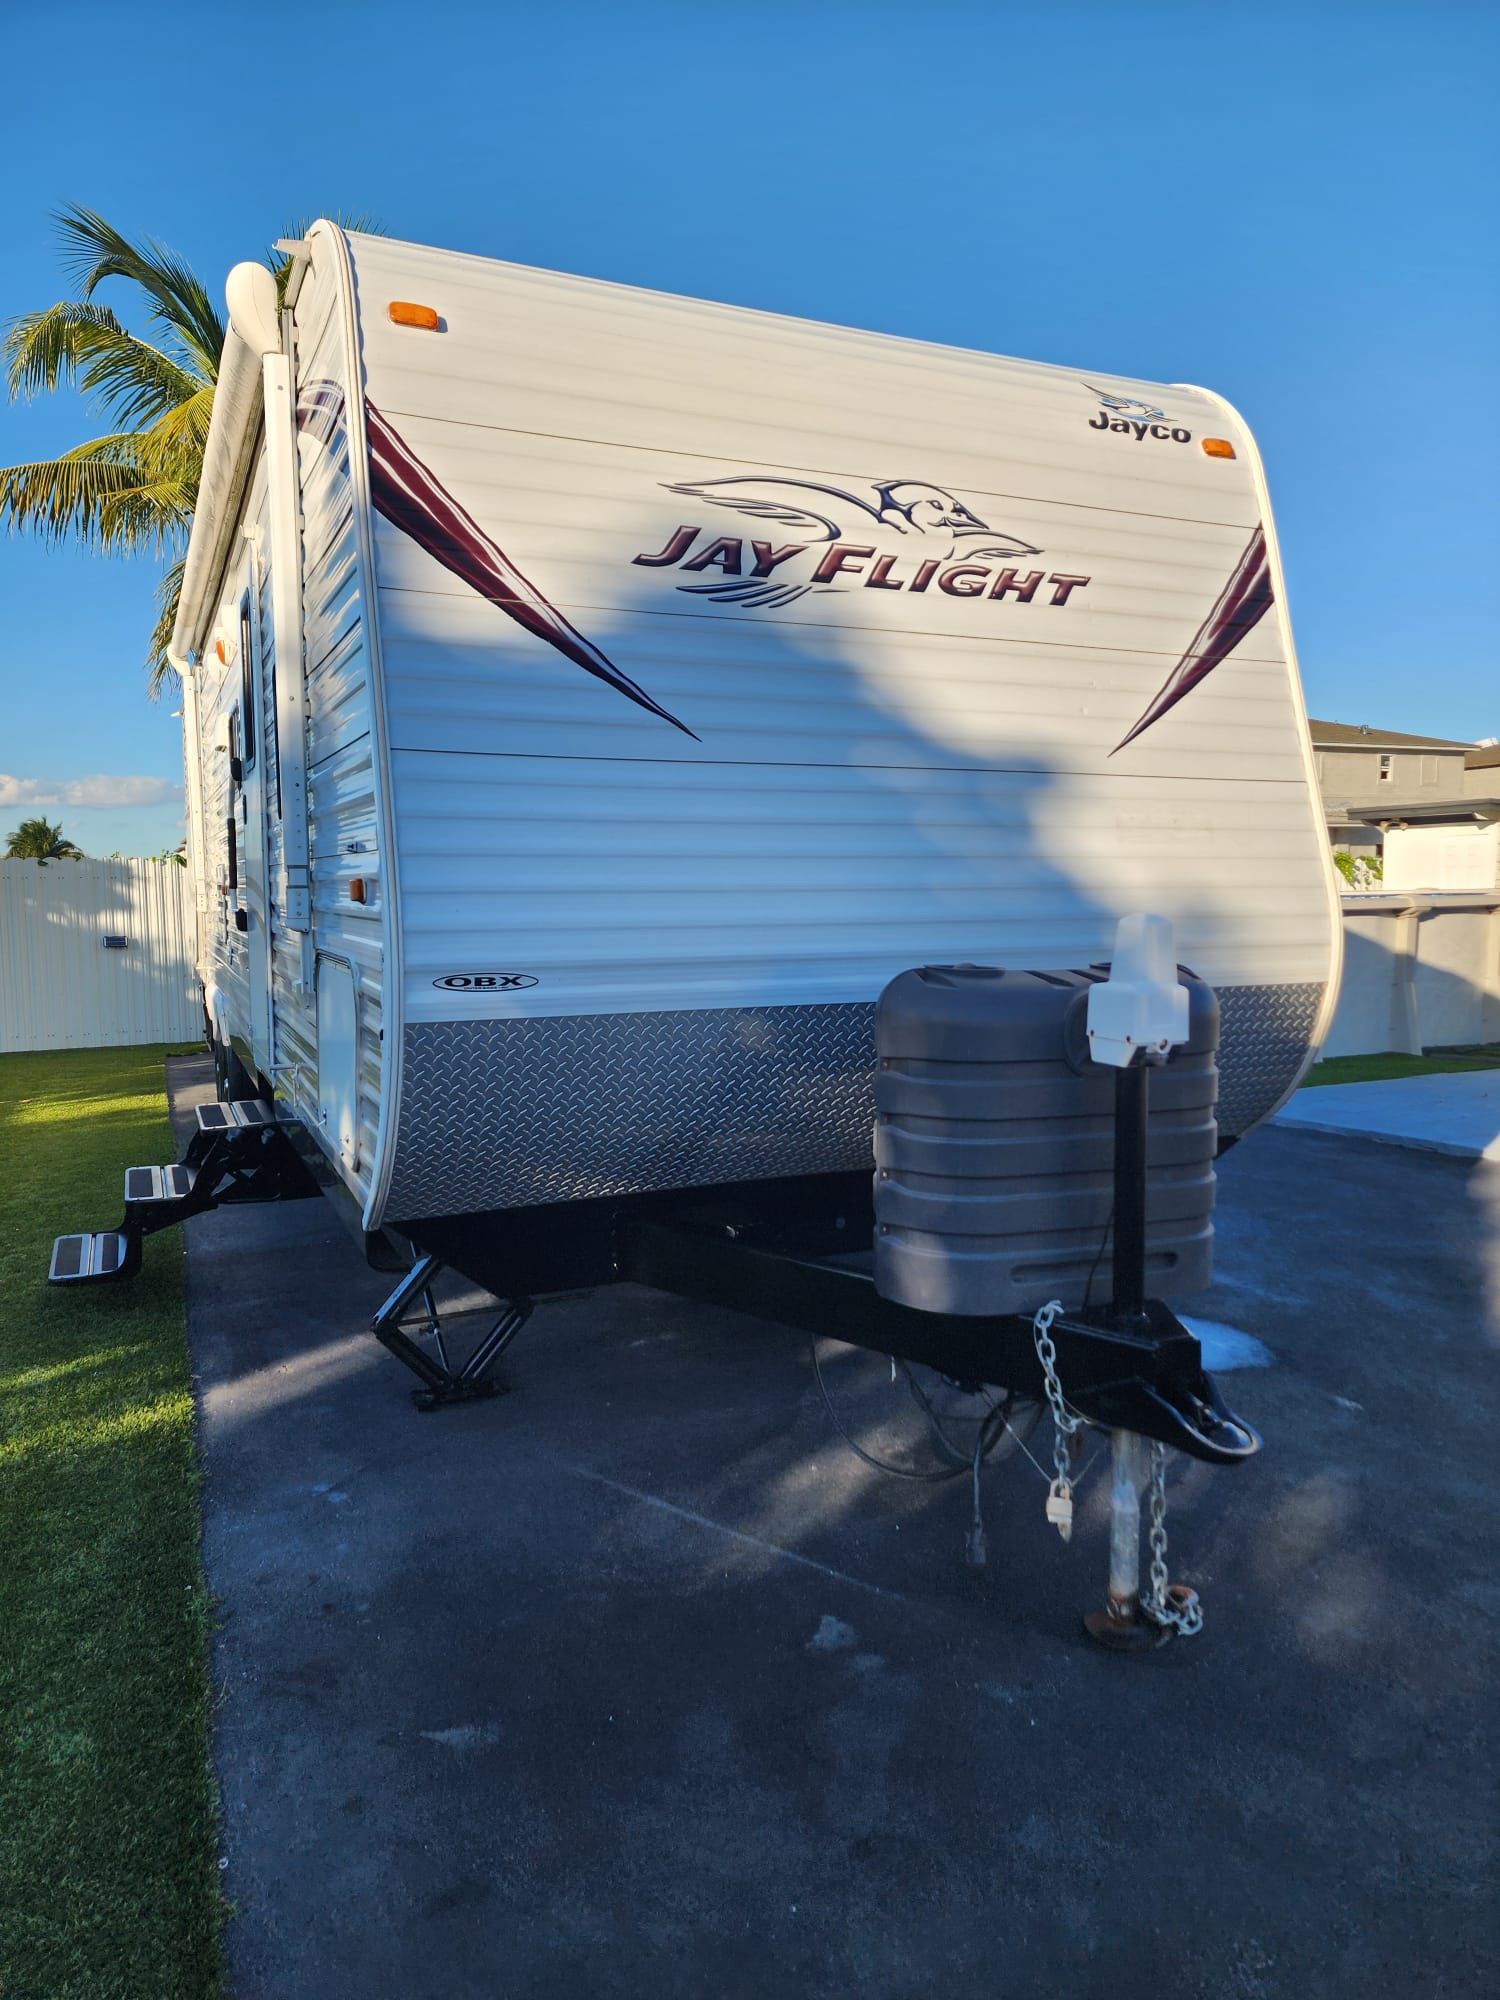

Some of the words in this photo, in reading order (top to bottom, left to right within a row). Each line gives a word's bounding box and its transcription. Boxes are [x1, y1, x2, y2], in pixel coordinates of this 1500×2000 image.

[1089, 411, 1191, 443] Jayco
[631, 525, 810, 577] JAY
[810, 542, 1092, 606] FLIGHT
[444, 976, 522, 987] OBX
